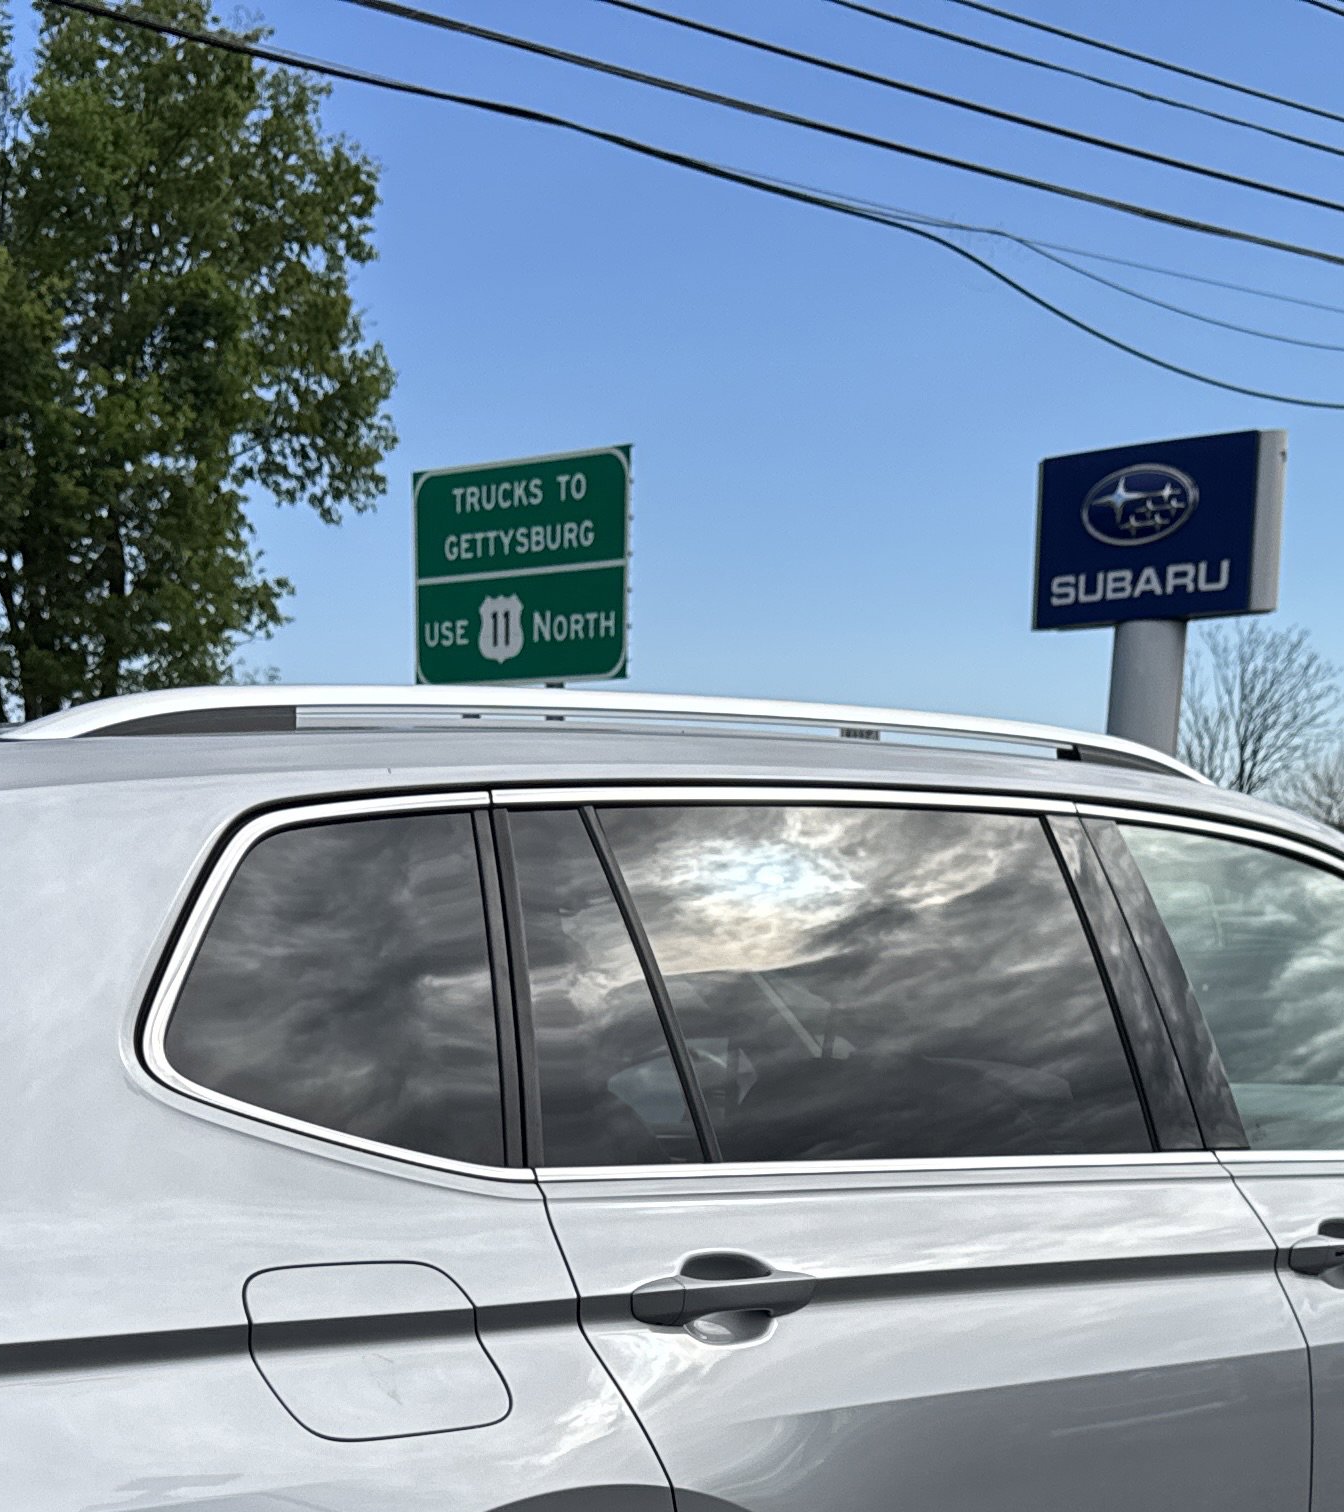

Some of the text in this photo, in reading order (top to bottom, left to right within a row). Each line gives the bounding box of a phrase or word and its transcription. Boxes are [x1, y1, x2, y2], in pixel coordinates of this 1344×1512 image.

[452, 472, 587, 515] TRUCKS TO
[444, 519, 596, 562] GETTYSBURG
[1049, 558, 1231, 608] SUBARU
[424, 618, 470, 648] USE
[491, 610, 511, 648] 11
